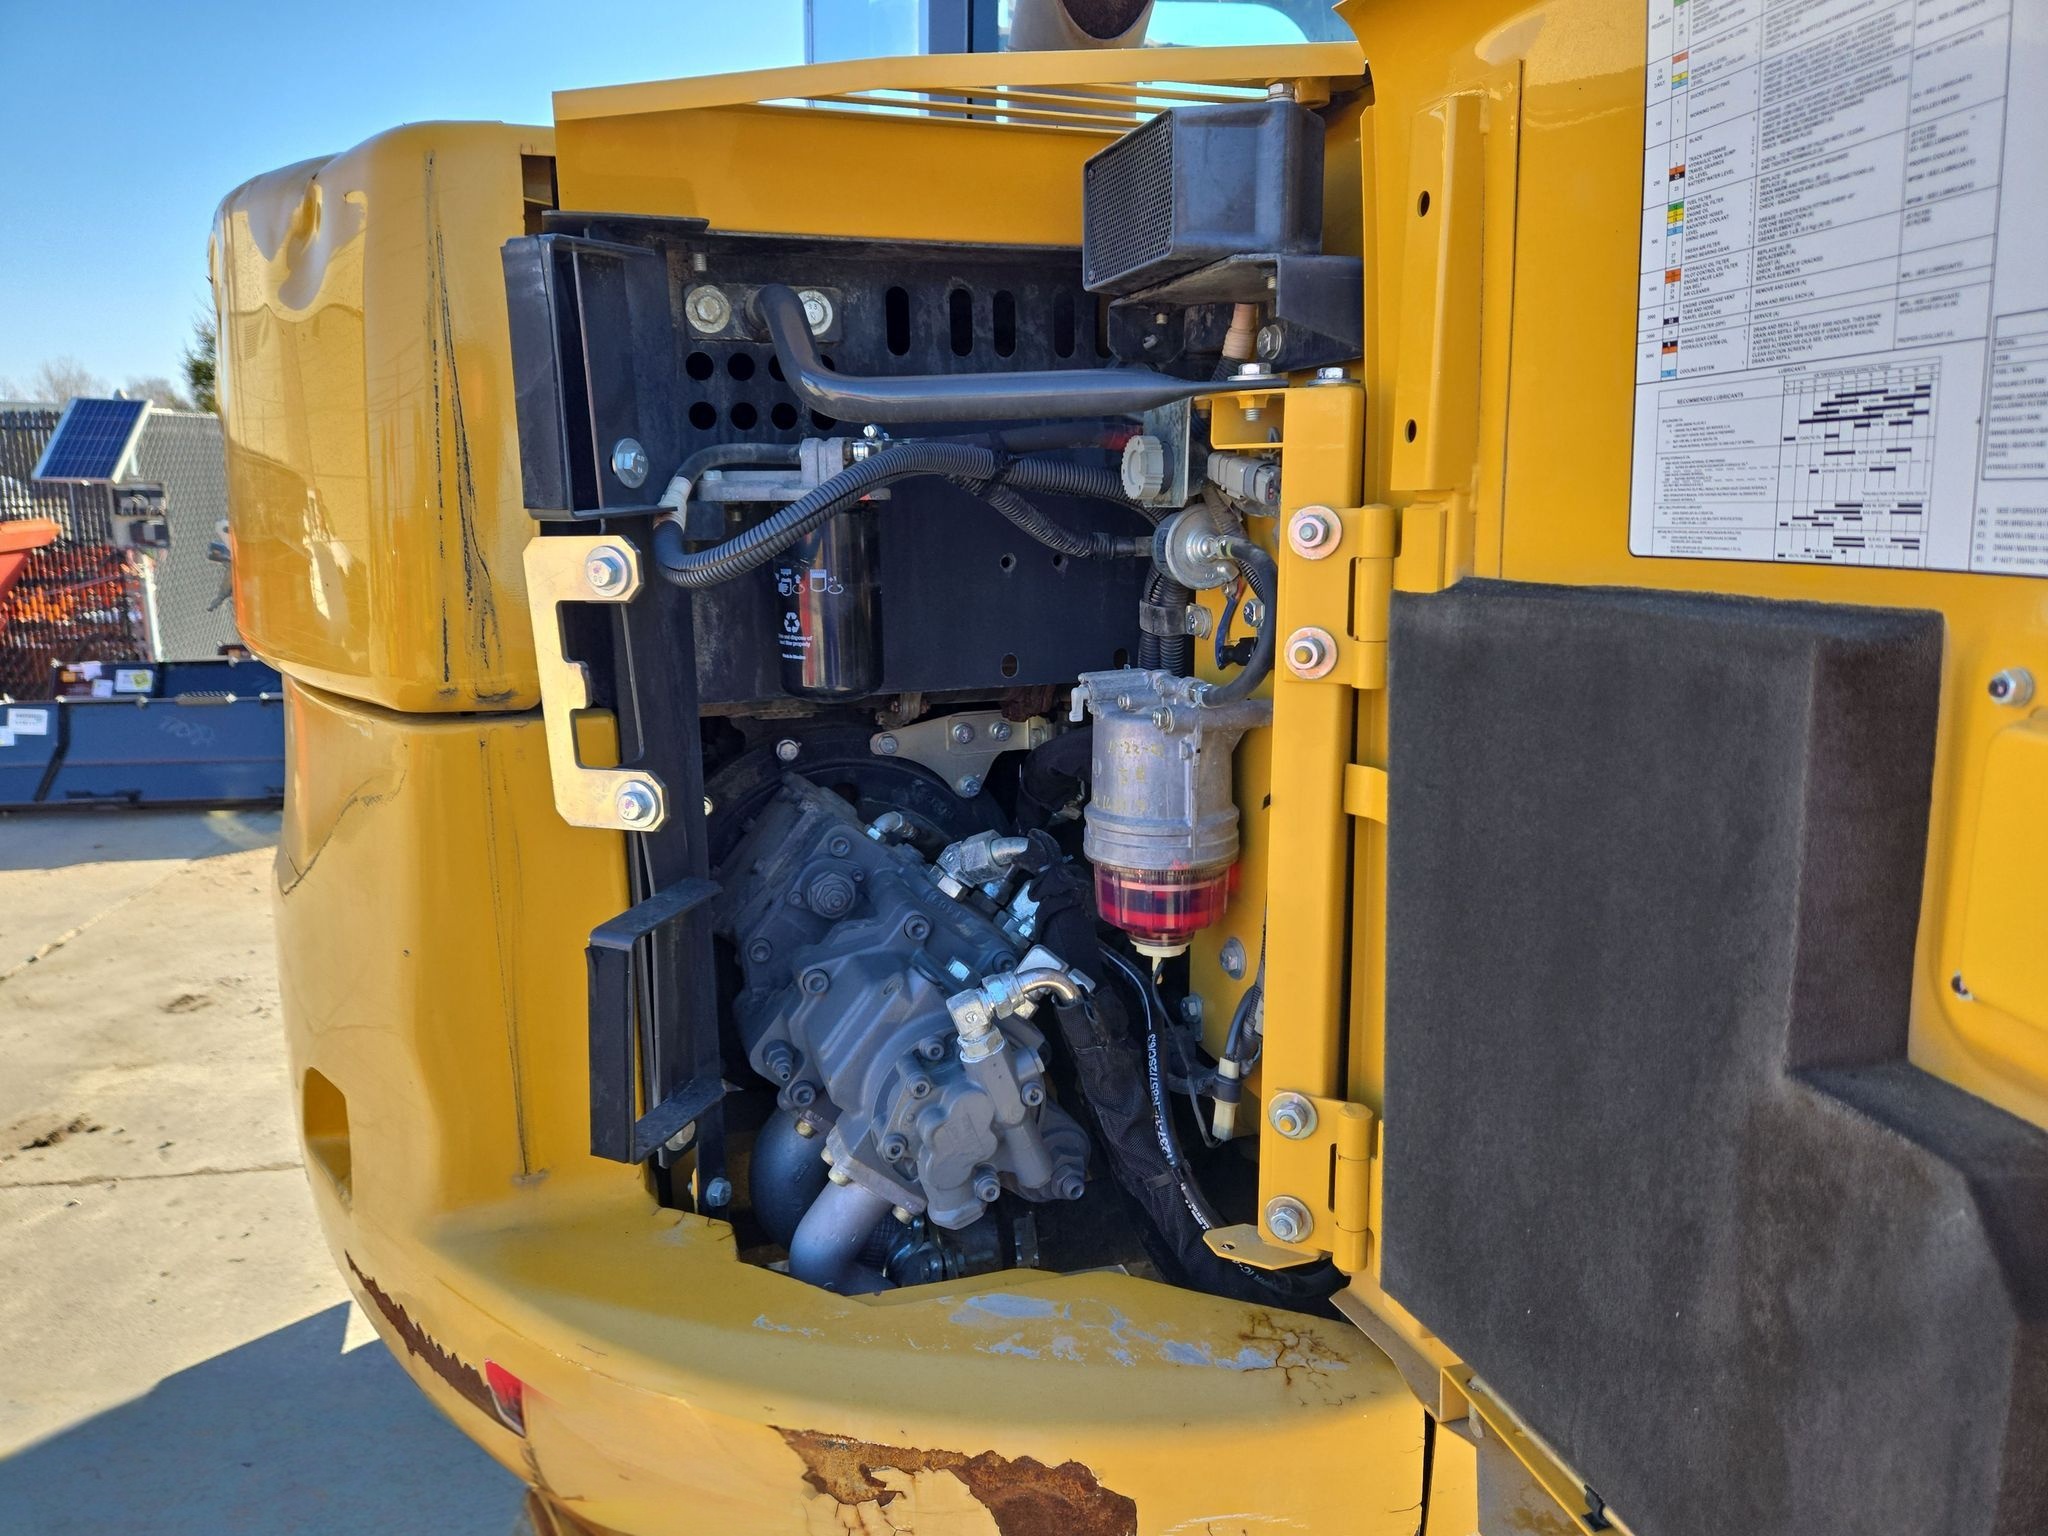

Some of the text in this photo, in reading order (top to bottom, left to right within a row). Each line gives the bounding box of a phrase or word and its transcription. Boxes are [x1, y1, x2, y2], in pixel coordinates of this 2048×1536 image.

[1689, 134, 1702, 144] BLADE
[1676, 391, 1743, 404] RECOMMENDED LUBRICANTS
